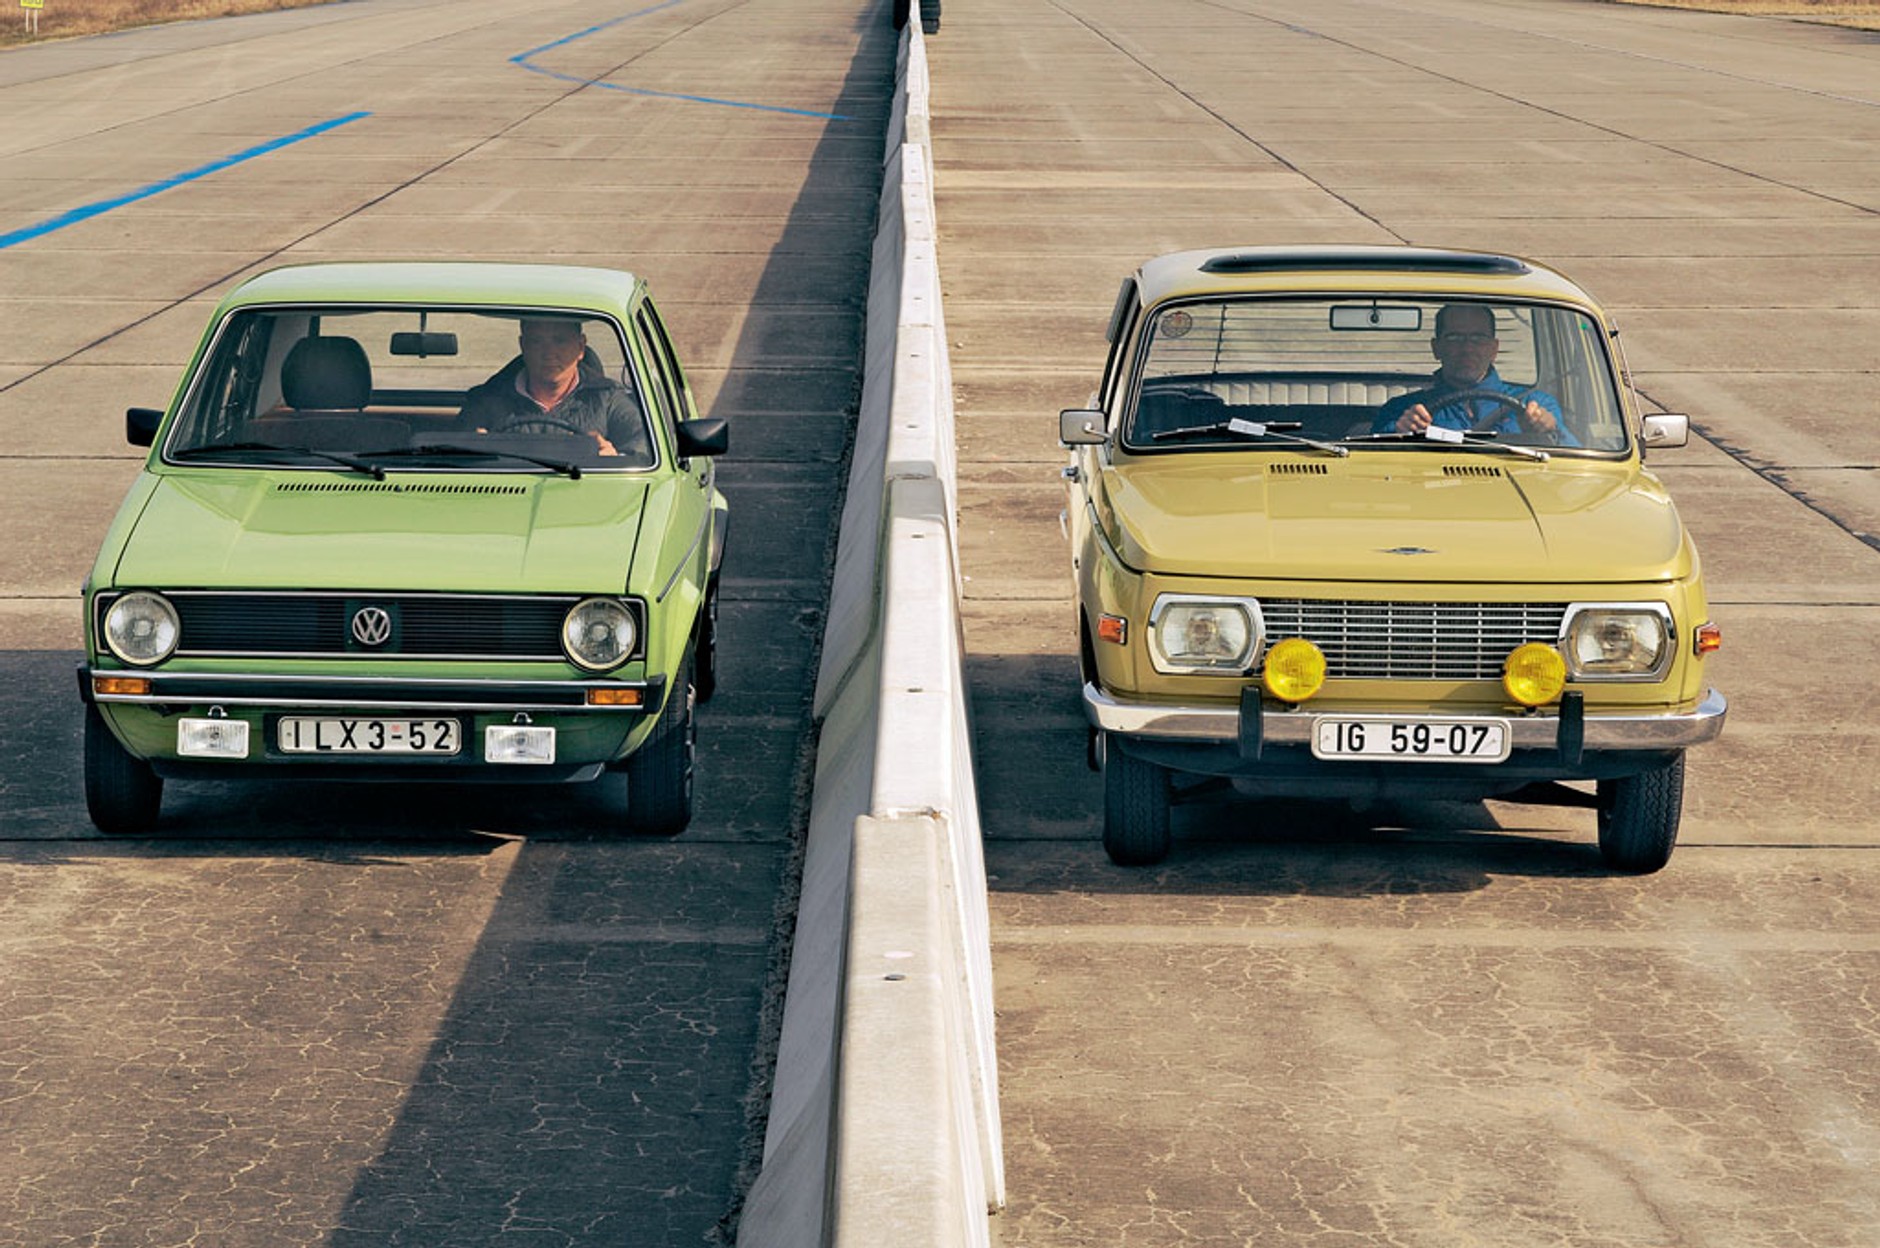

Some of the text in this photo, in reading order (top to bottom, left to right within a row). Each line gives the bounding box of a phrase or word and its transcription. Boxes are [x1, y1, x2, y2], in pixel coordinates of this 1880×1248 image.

[353, 607, 390, 645] VW
[1337, 722, 1489, 754] IG 59-07
